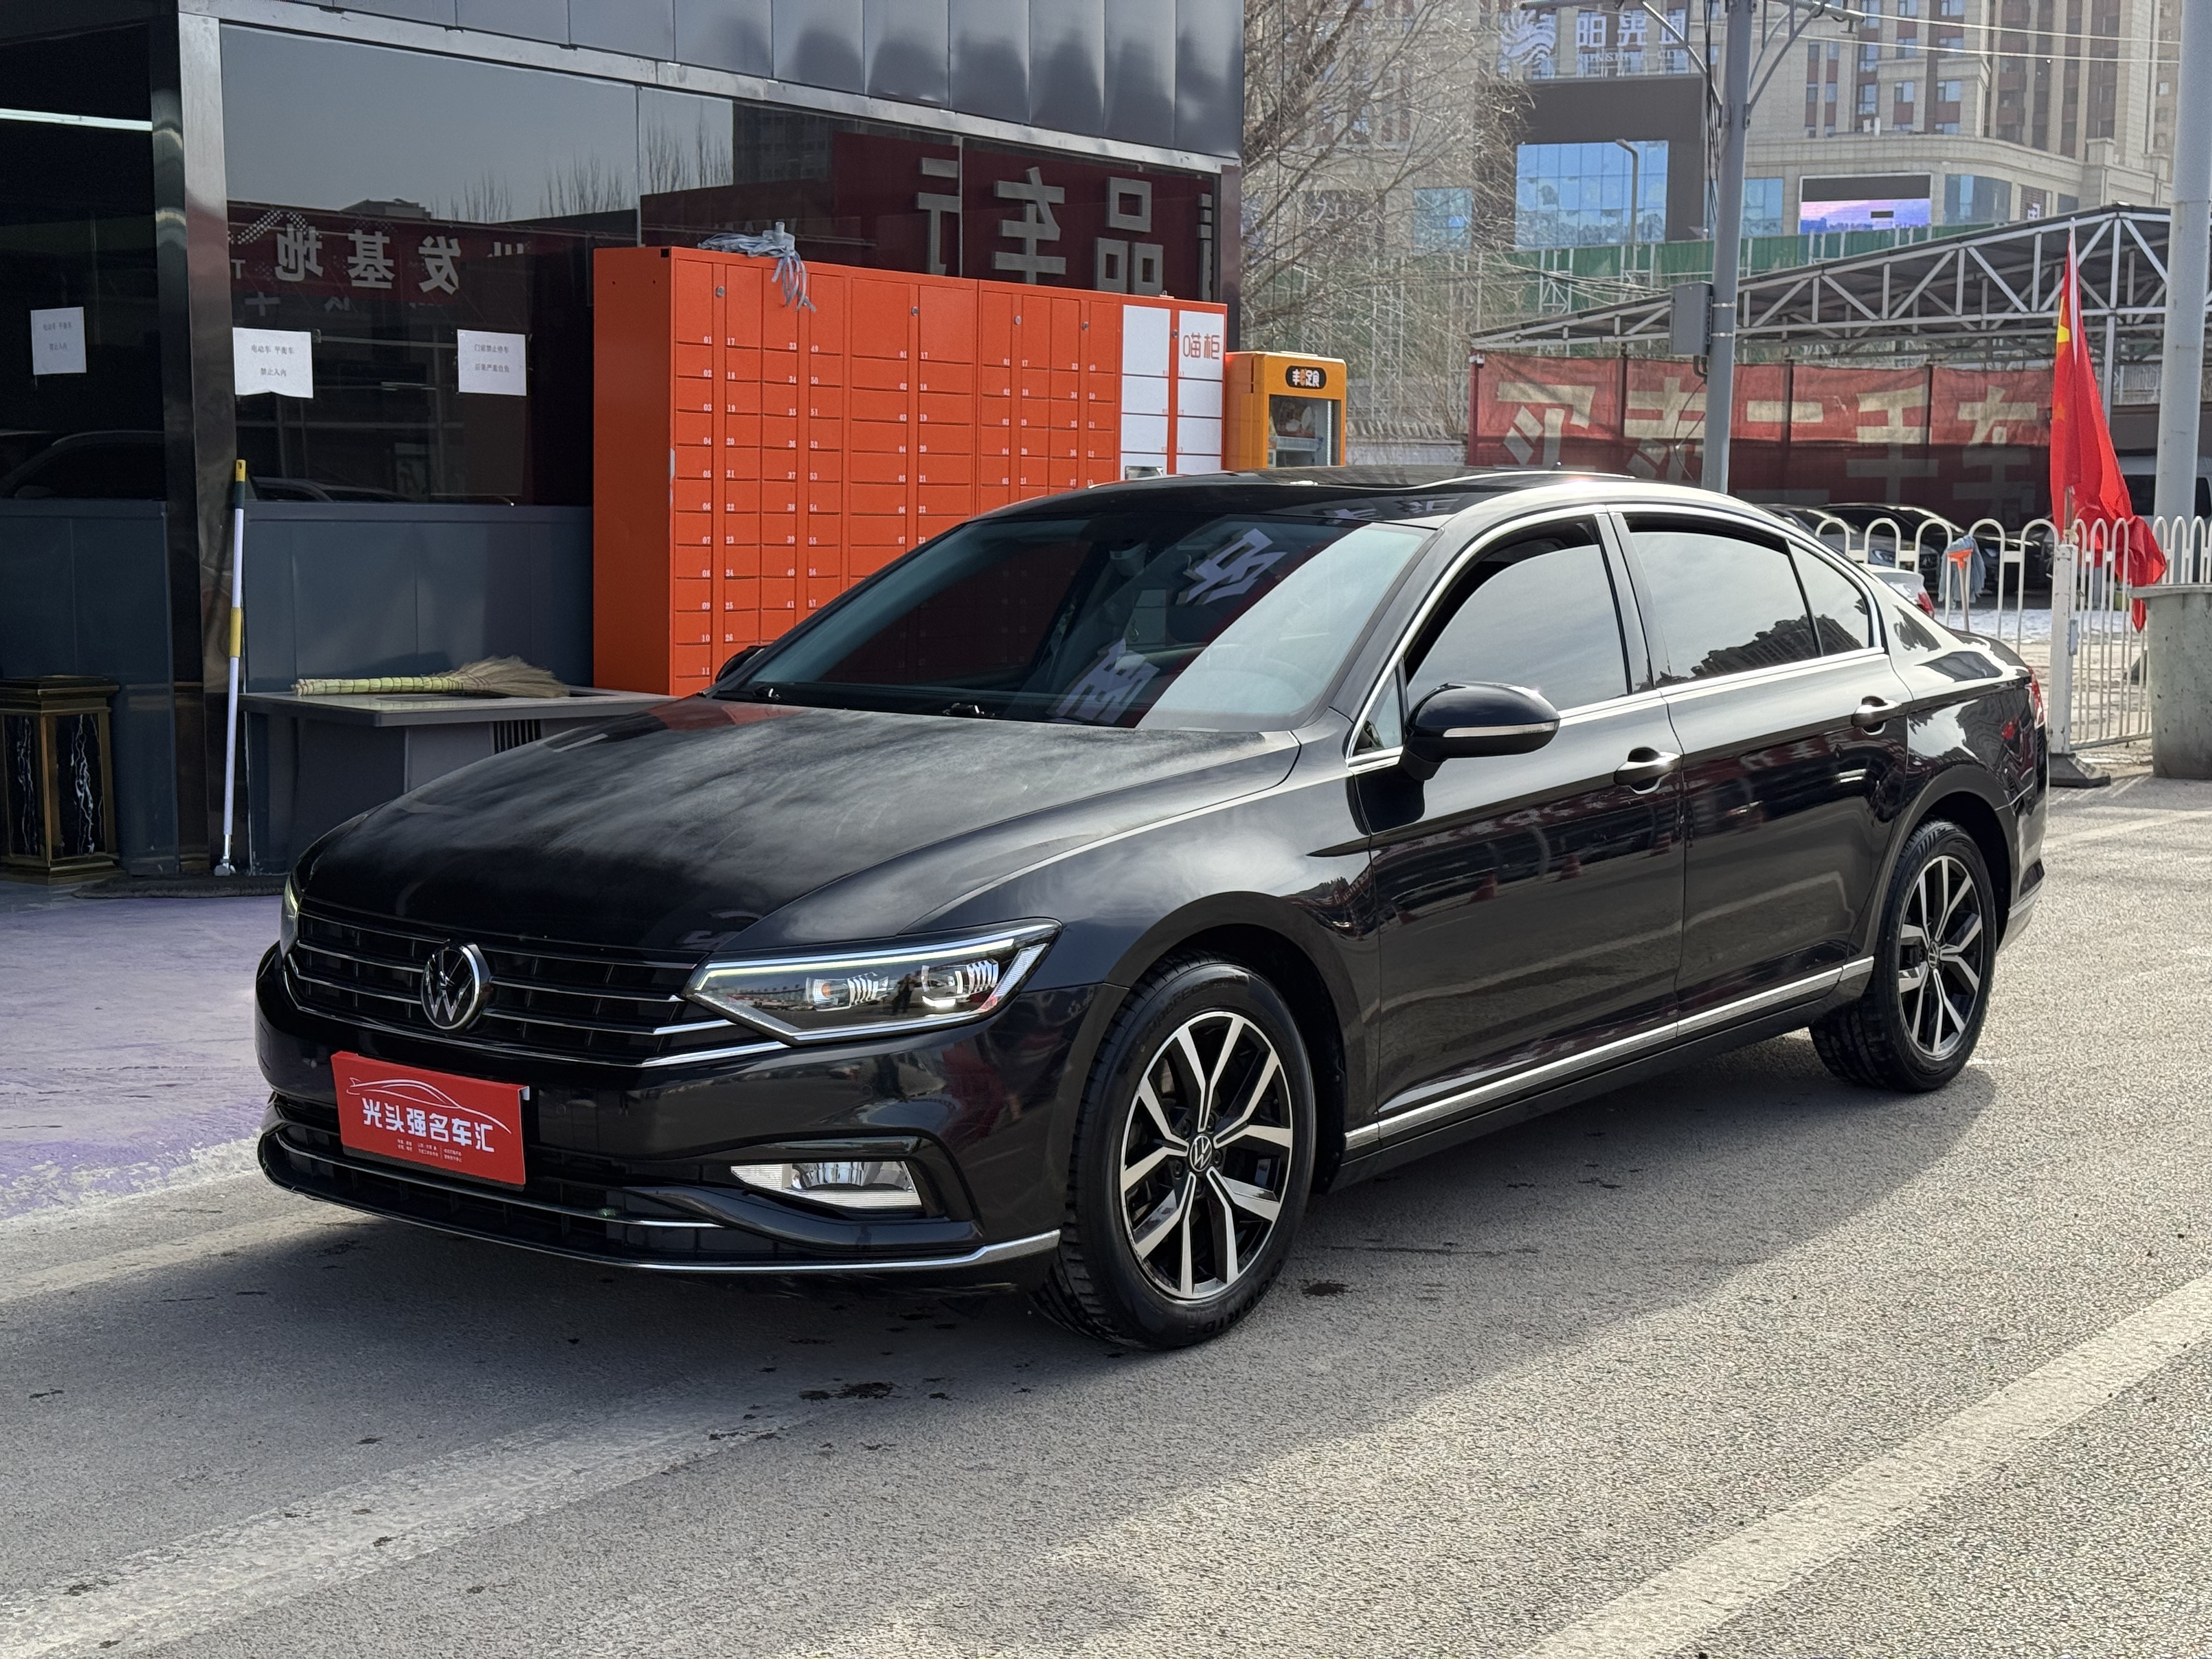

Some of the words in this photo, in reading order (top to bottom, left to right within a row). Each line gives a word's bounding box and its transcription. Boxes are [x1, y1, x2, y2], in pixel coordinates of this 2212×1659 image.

[251, 344, 271, 354] 电动车
[1183, 332, 1221, 360] 喵柜
[261, 368, 287, 377] 禁止入内
[362, 1097, 495, 1153] 光头强名车汇
